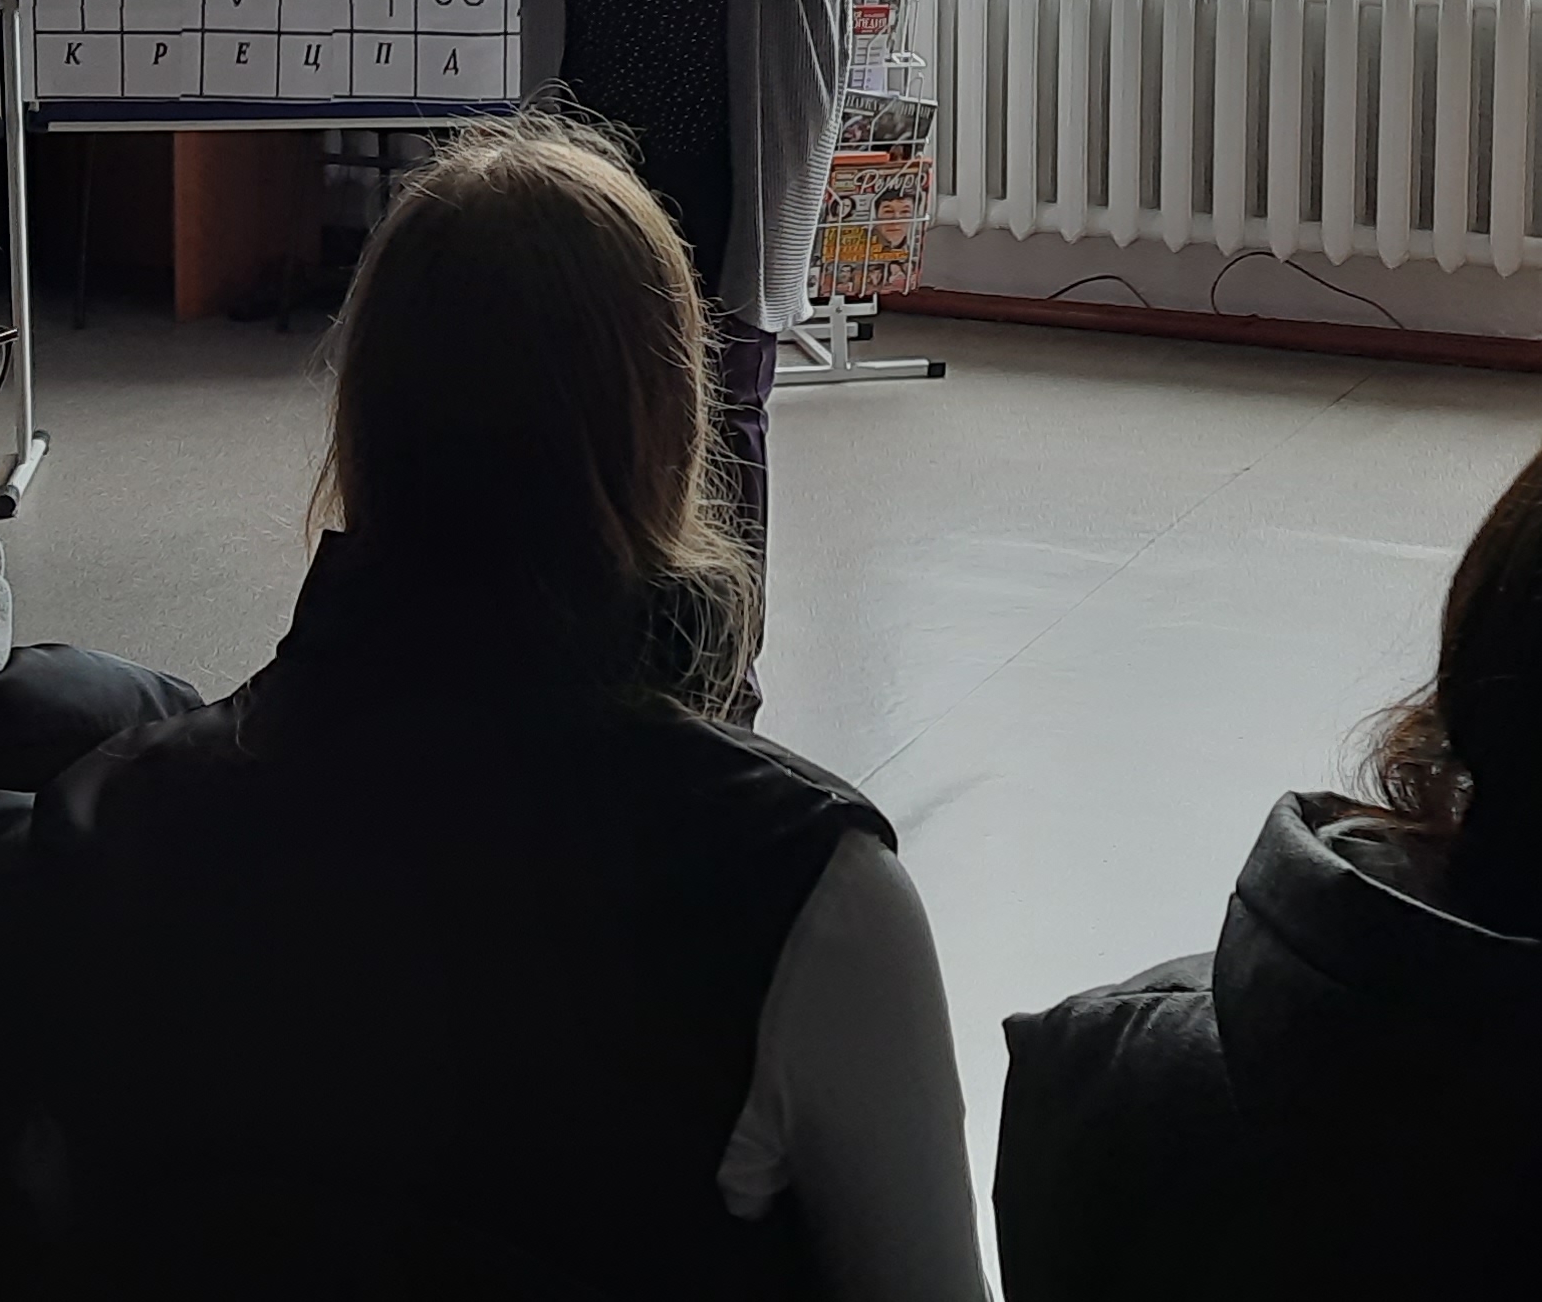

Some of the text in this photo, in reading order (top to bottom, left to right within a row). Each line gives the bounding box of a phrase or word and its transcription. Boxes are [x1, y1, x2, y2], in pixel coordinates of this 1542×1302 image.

[65, 42, 459, 76] К Р Е Ц П Д
